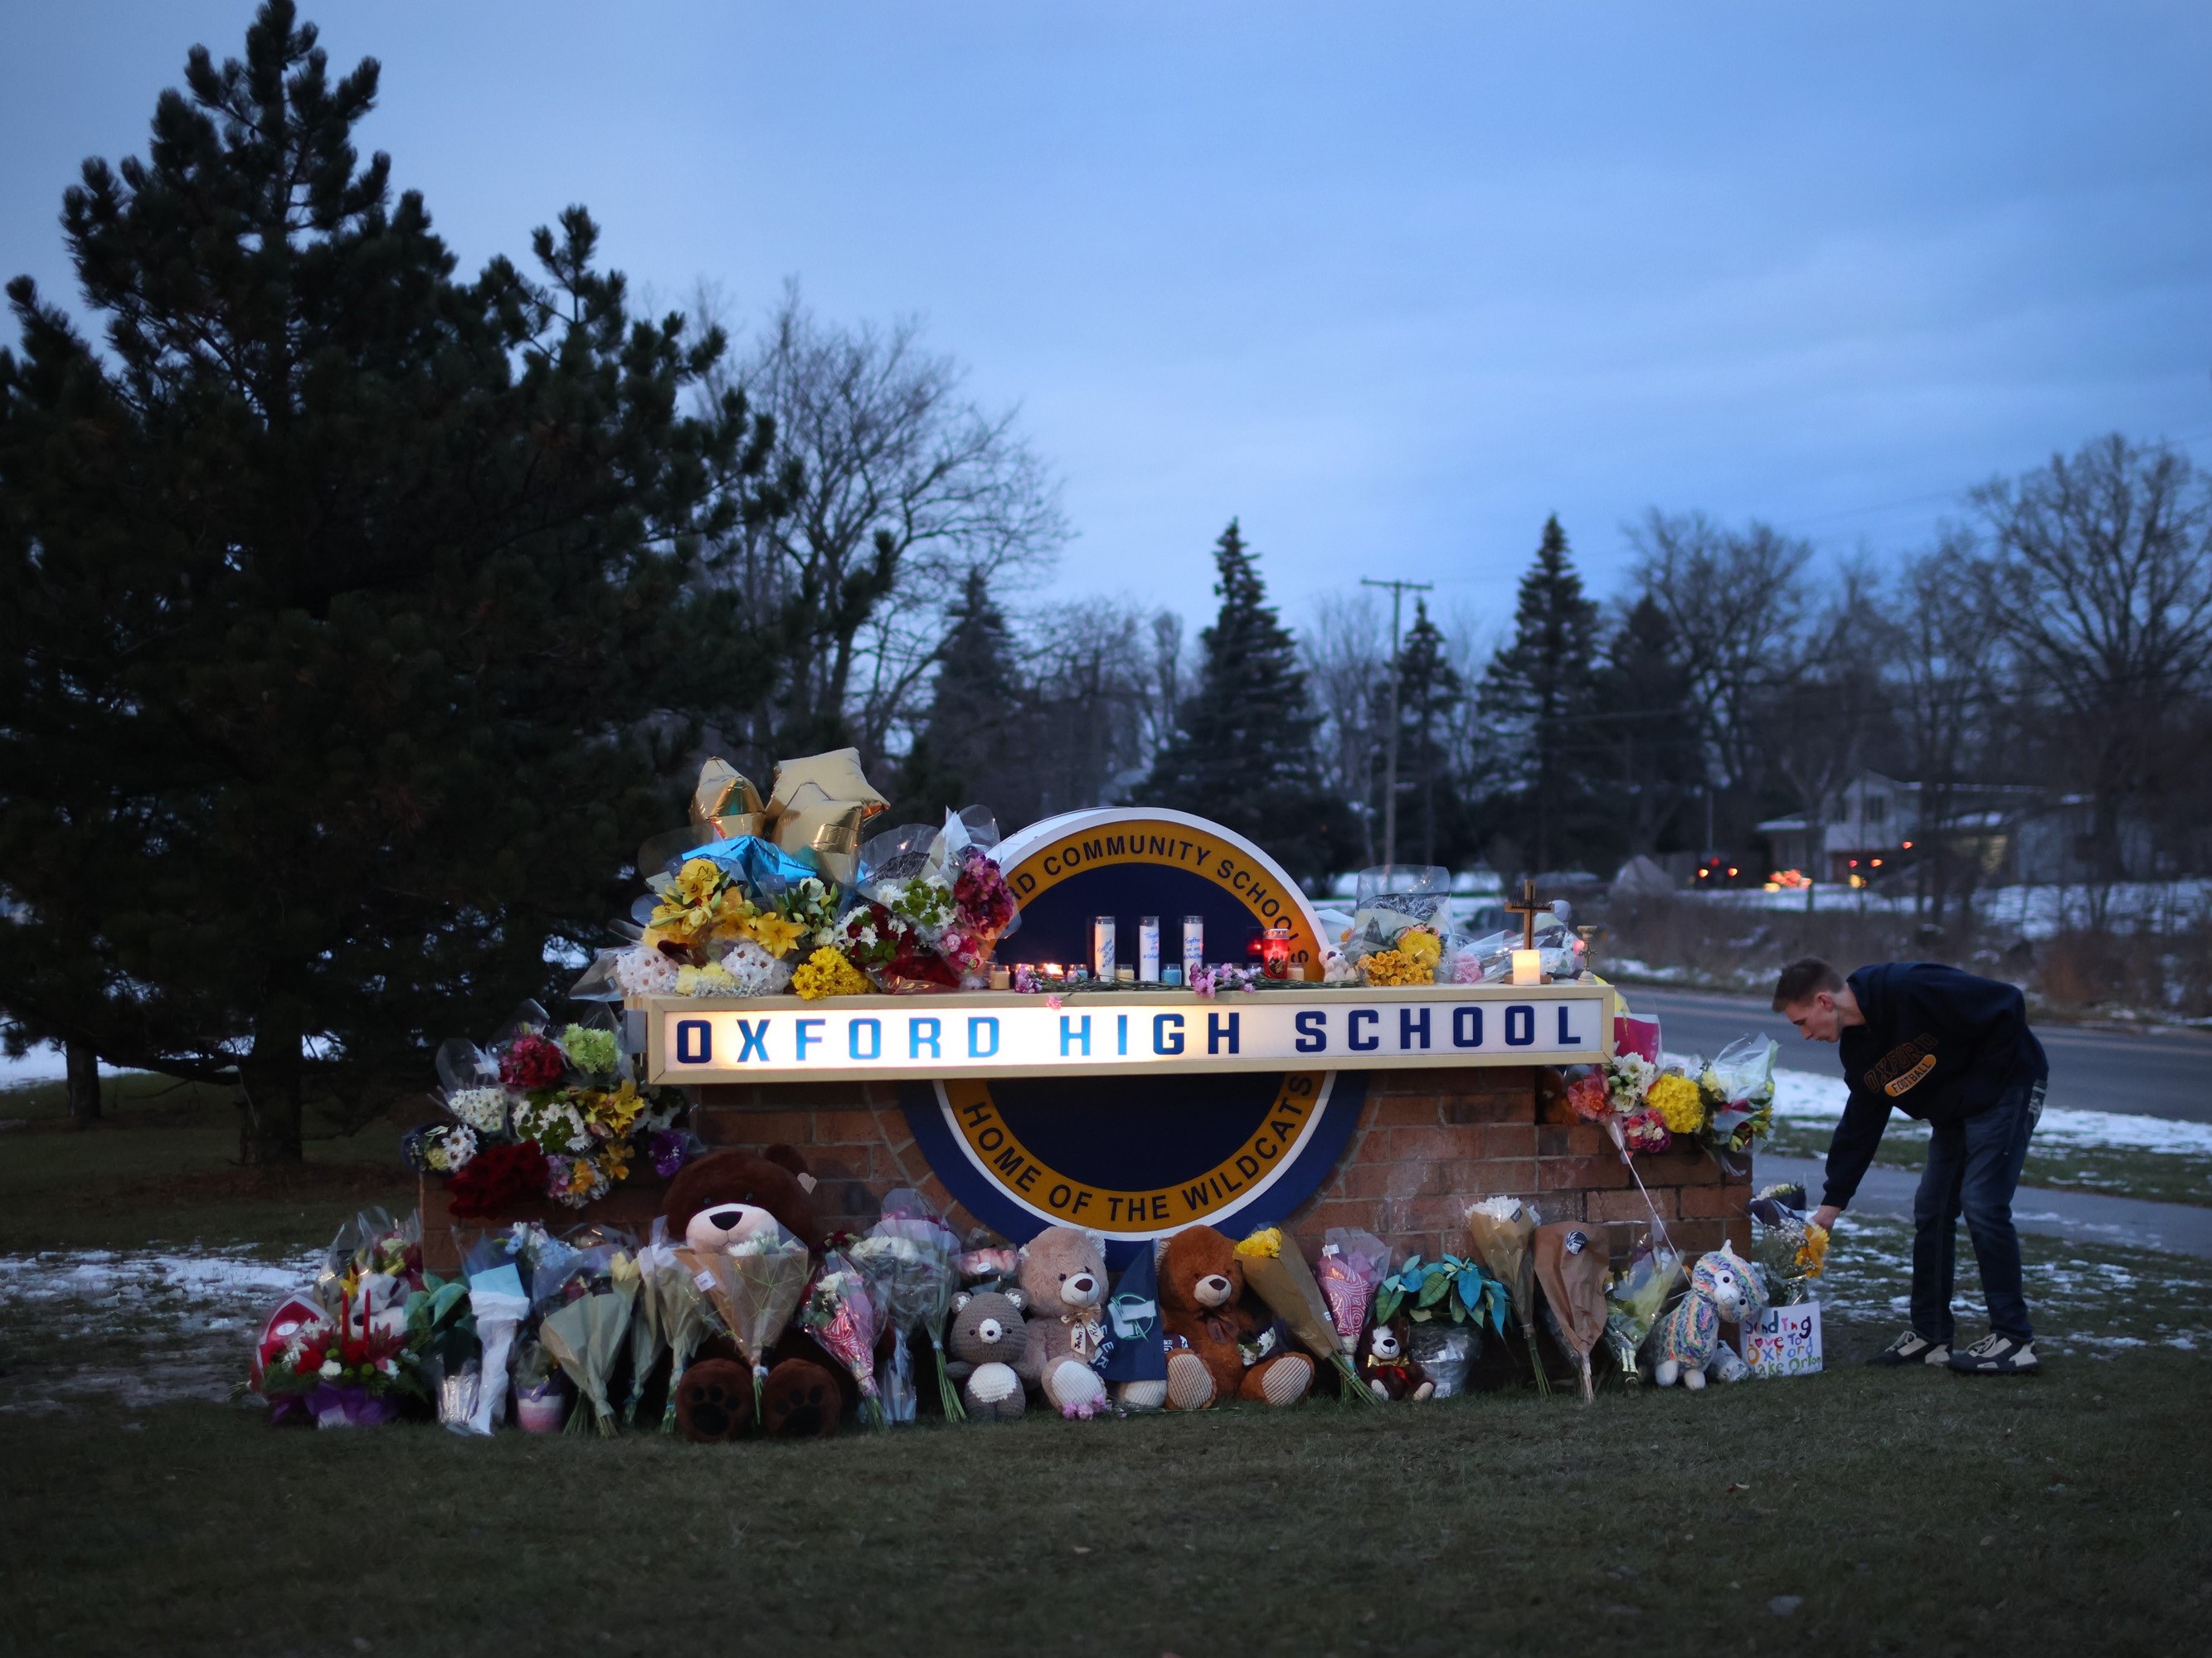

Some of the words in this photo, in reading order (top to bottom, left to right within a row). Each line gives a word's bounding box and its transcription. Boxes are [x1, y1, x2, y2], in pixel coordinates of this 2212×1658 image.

[1043, 834, 1212, 877] COMMUNITY
[677, 1017, 999, 1063] OXFORD
[1060, 1011, 1240, 1057] HIGH
[1295, 1004, 1582, 1053] SCHOOL
[1864, 1033, 1938, 1093] OXFORD
[1891, 1062, 1932, 1093] FOOTBALL
[962, 1101, 1043, 1192] HOME
[1048, 1184, 1093, 1214] OF
[1107, 1194, 1170, 1222] THE
[1182, 1075, 1314, 1211] WILDCATS
